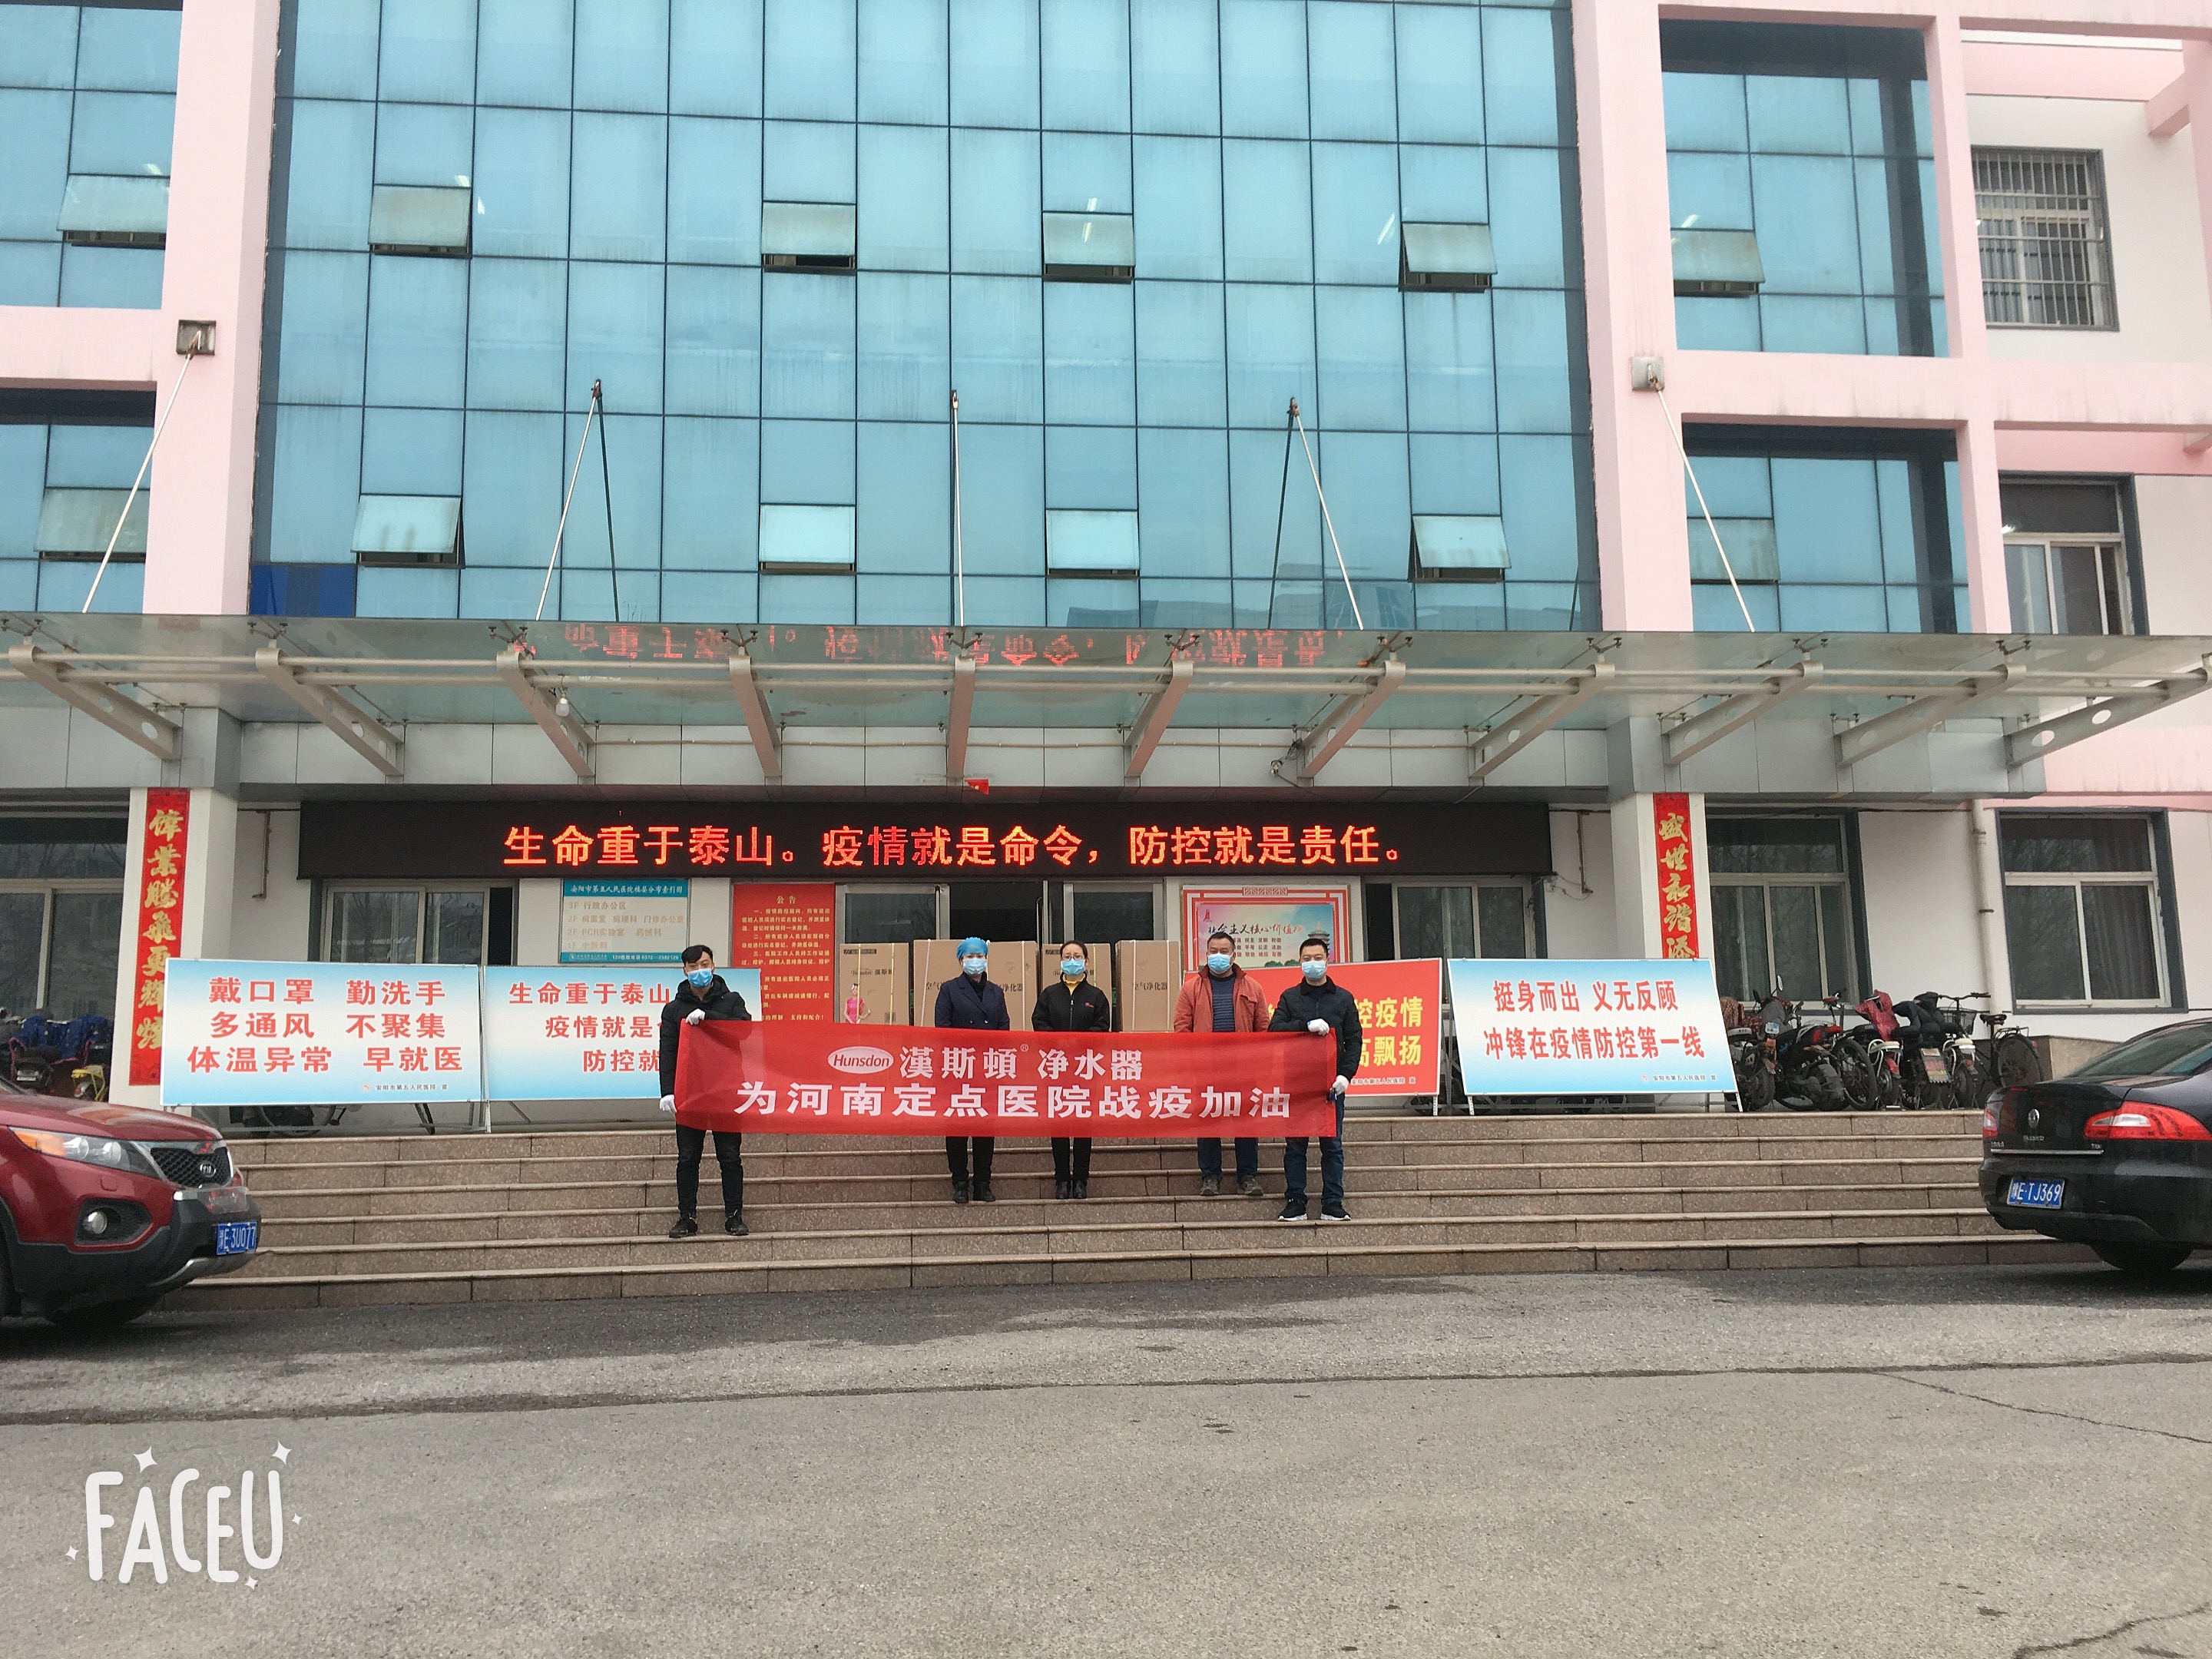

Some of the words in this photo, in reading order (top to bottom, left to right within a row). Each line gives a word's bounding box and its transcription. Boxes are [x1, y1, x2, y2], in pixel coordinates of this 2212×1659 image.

[583, 901, 626, 910] 行政办公区
[208, 976, 316, 1005] 戴口罩
[346, 979, 445, 1007] 勤洗手
[508, 982, 670, 1005] 生命重于泰山
[1492, 980, 1581, 1013] 挺身而出
[1592, 980, 1679, 1012] 义无反顾
[210, 1010, 316, 1039] 多通风
[346, 1012, 445, 1039] 不聚集
[545, 1015, 661, 1038] 疫情就是
[1485, 1026, 1706, 1061] 冲锋在疫情防控第一线
[187, 1045, 333, 1074] 体温异常
[363, 1046, 463, 1073] 早就医
[833, 1053, 890, 1068] Hunsdon
[1037, 1048, 1143, 1081] 净水器
[734, 1081, 1291, 1119] 为河南定点医院战疫加油
